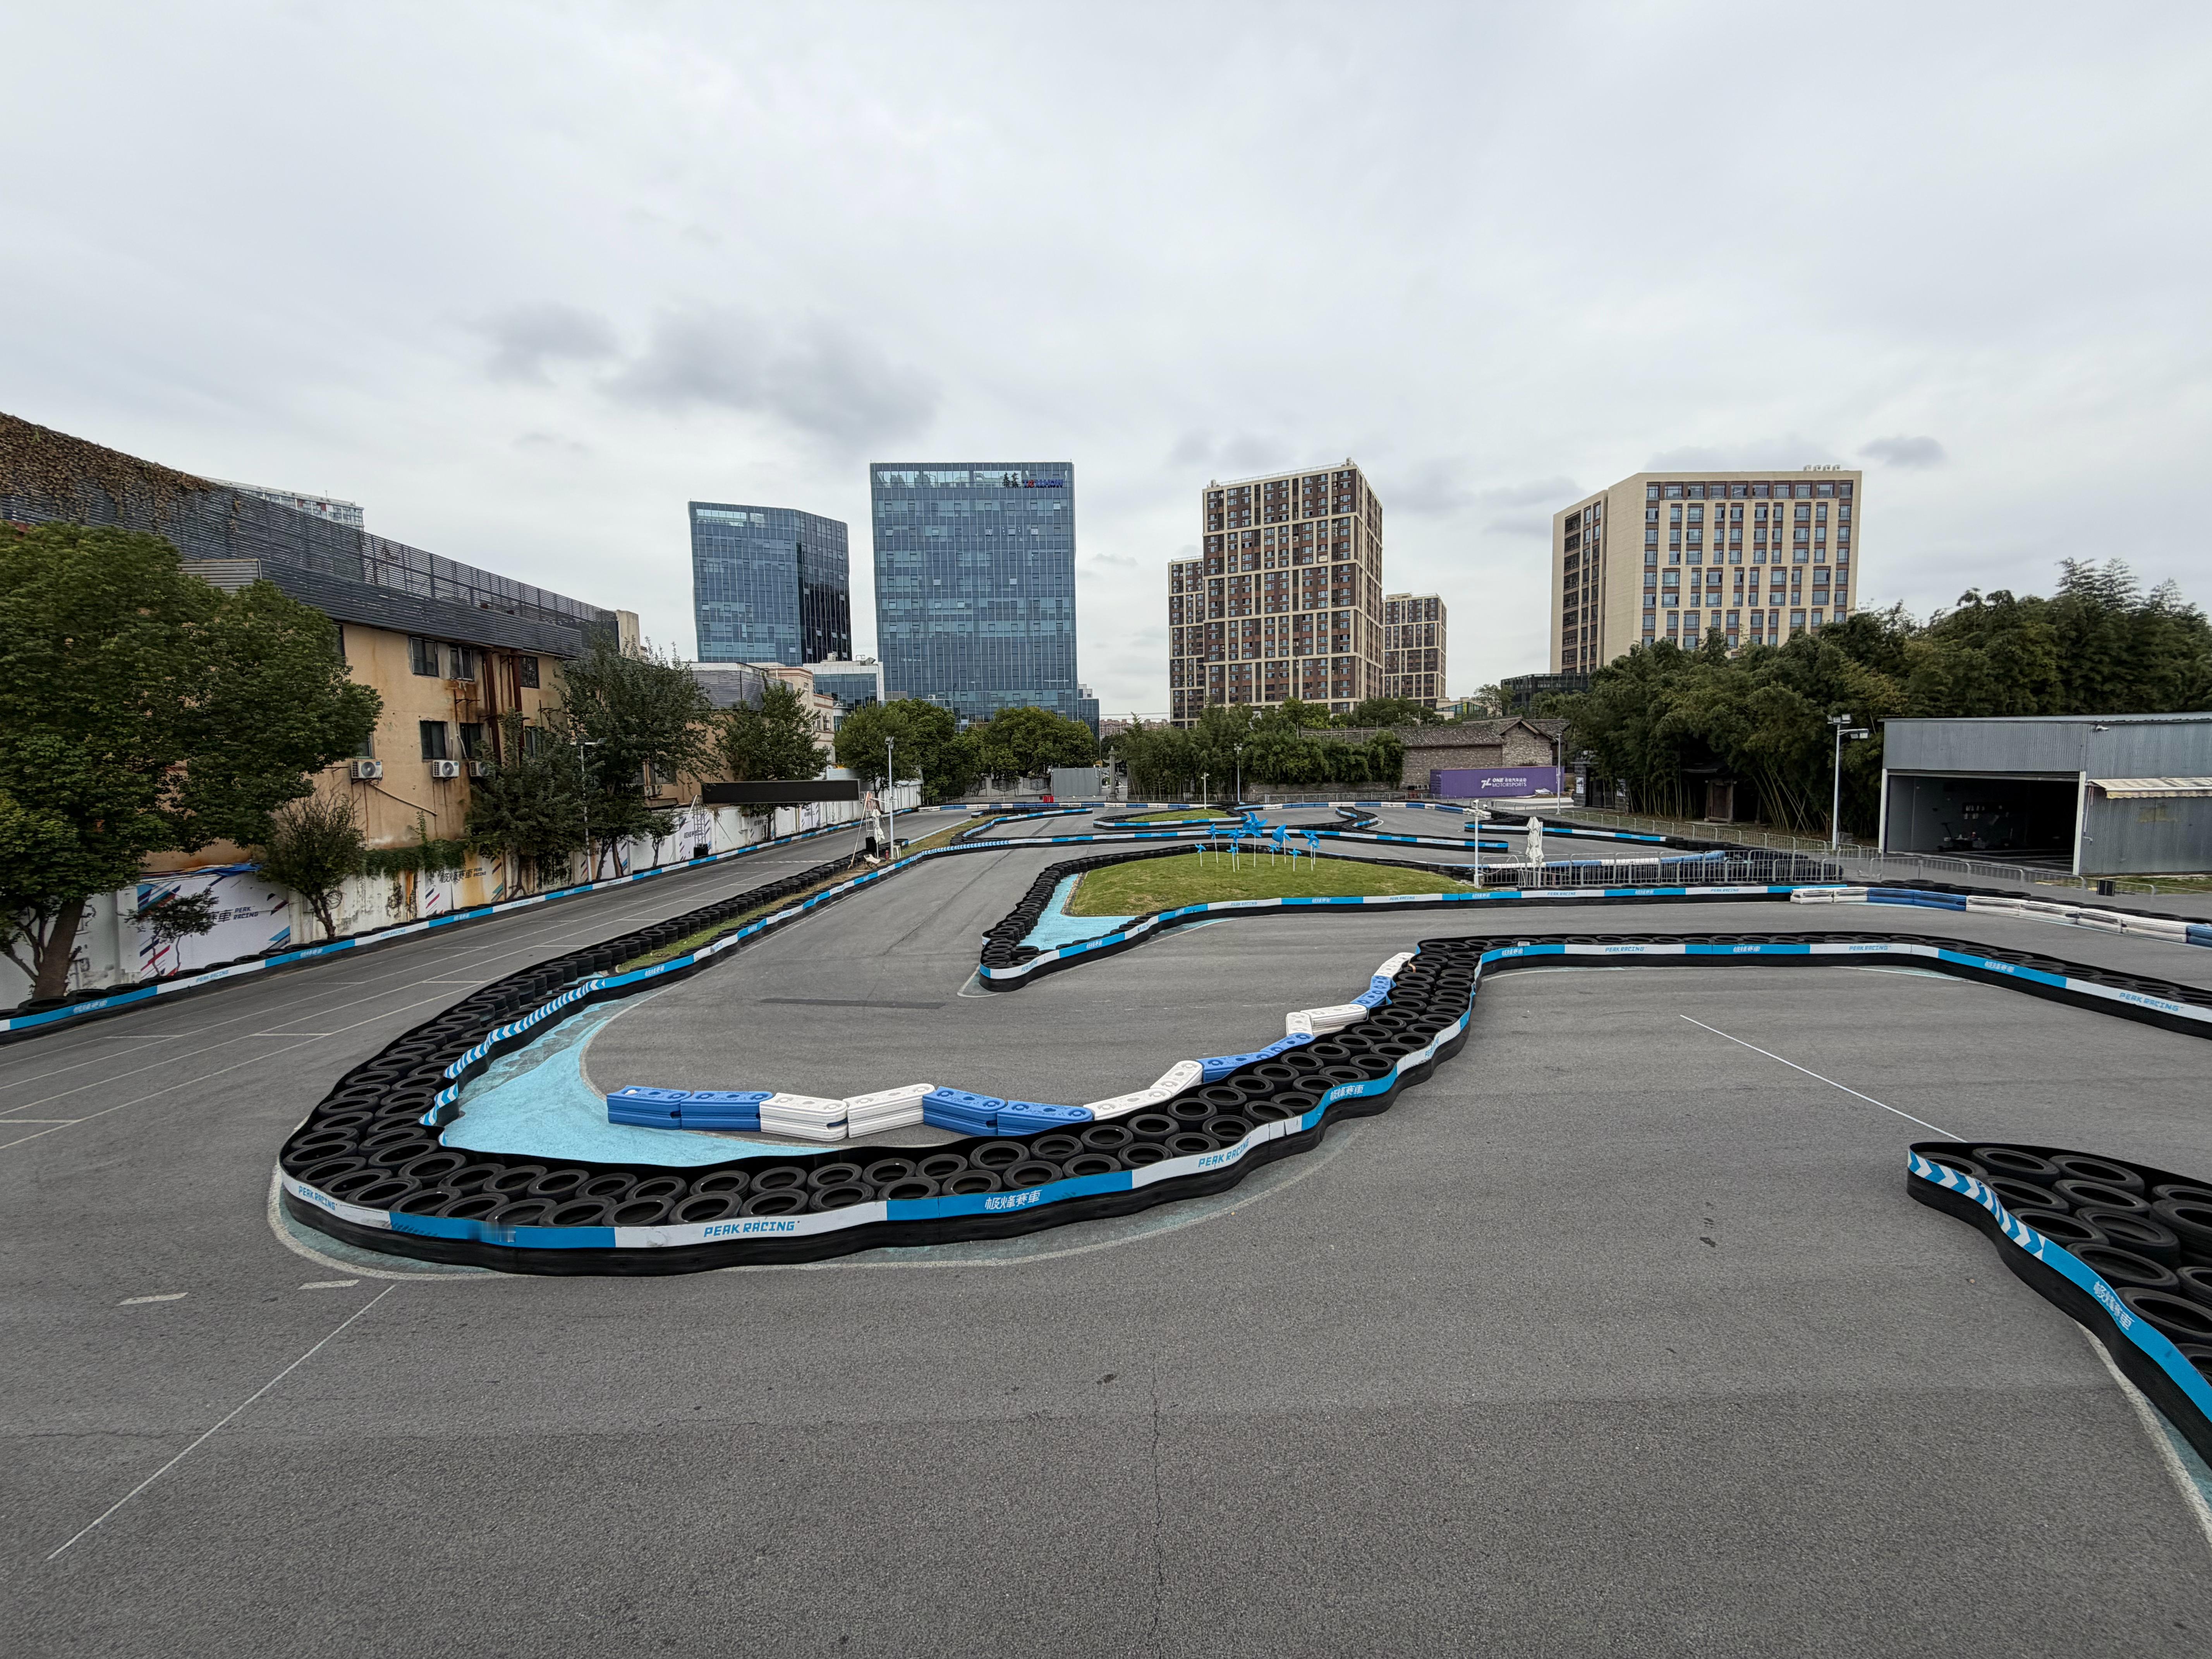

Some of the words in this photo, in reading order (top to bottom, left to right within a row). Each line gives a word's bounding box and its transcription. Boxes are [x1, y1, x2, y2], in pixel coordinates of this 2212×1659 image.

[233, 912, 259, 920] RACING
[2119, 992, 2142, 1003] PEAK
[2143, 998, 2179, 1011] RACING
[1198, 1154, 1224, 1168] PEAK
[1226, 1138, 1249, 1161] RACING
[299, 1185, 314, 1199] PEAK
[315, 1192, 335, 1211] RACING
[704, 1224, 740, 1238] PEAK
[743, 1221, 795, 1233] RACING
